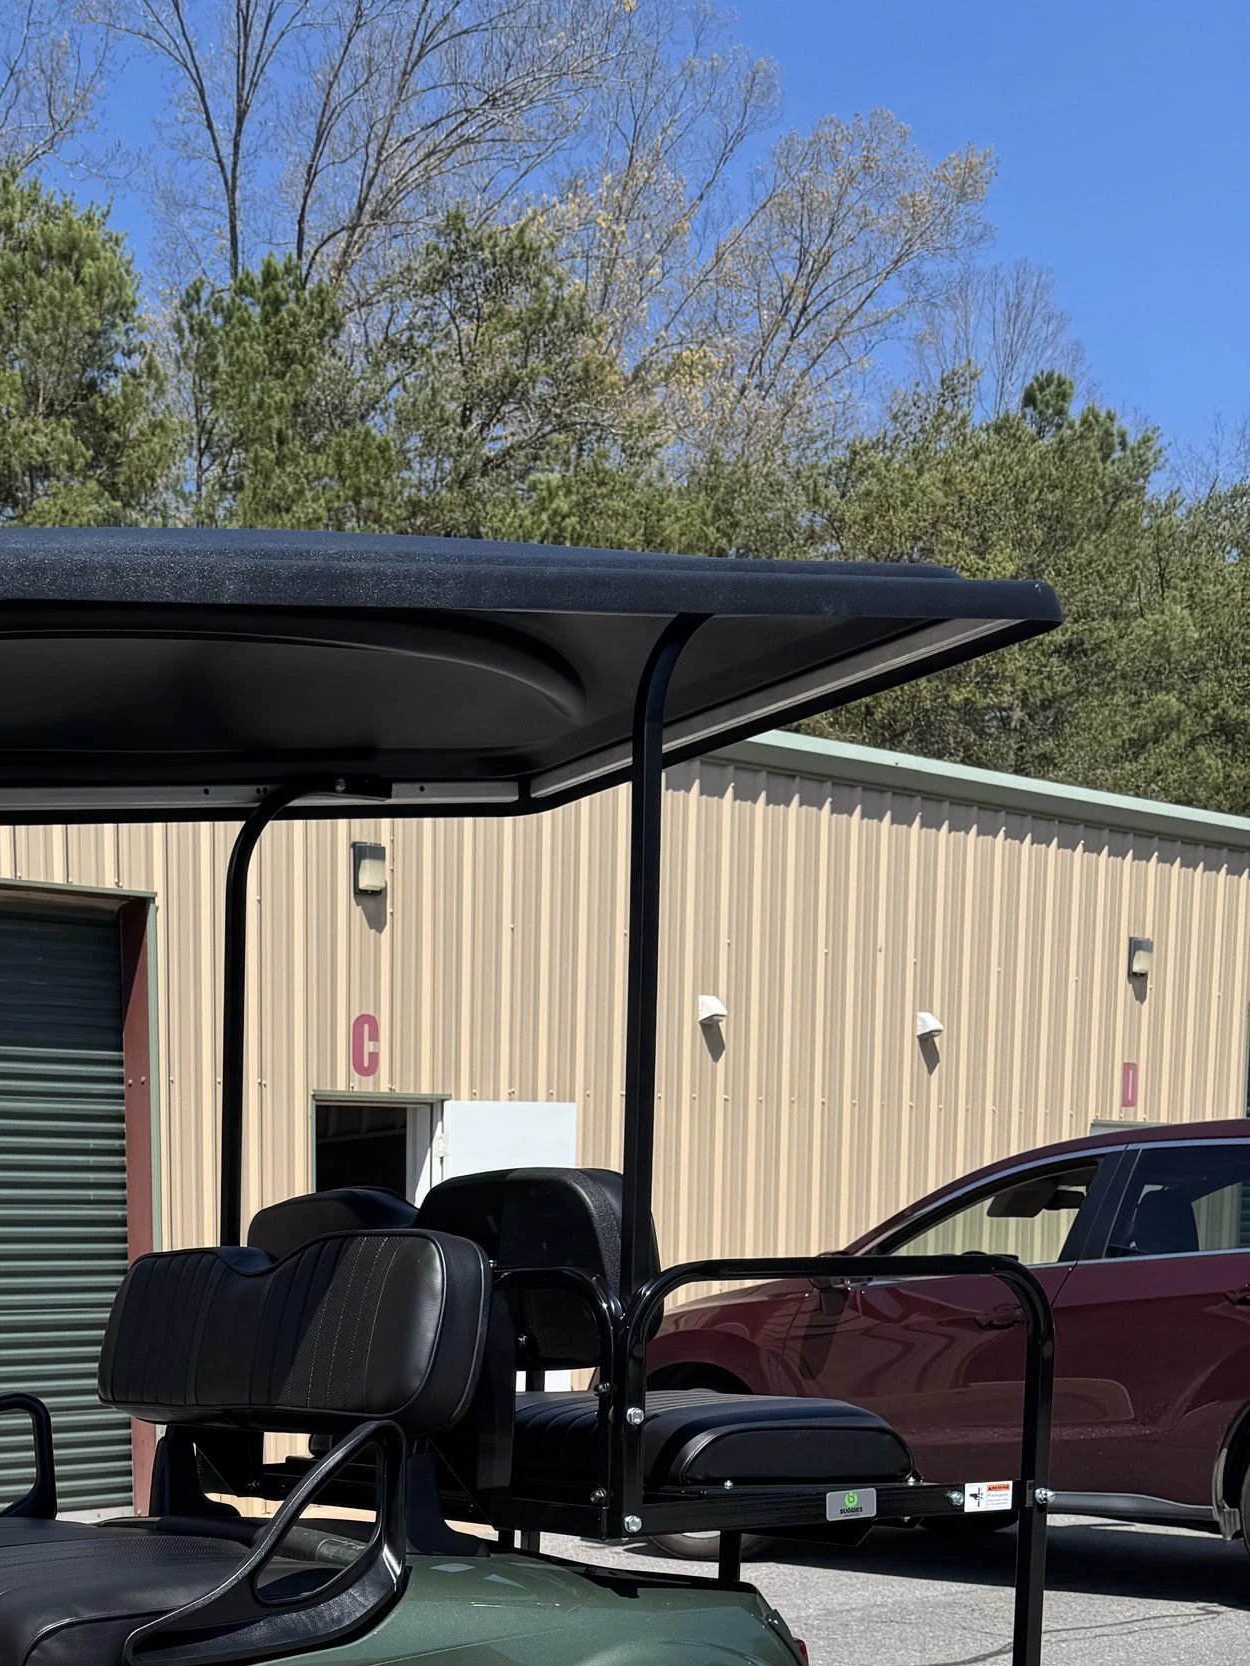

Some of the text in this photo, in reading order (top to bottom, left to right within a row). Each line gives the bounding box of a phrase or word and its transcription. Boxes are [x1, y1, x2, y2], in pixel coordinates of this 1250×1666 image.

[352, 1013, 379, 1077] C
[1121, 1062, 1138, 1107] D
[840, 1506, 863, 1515] BUGGIES
